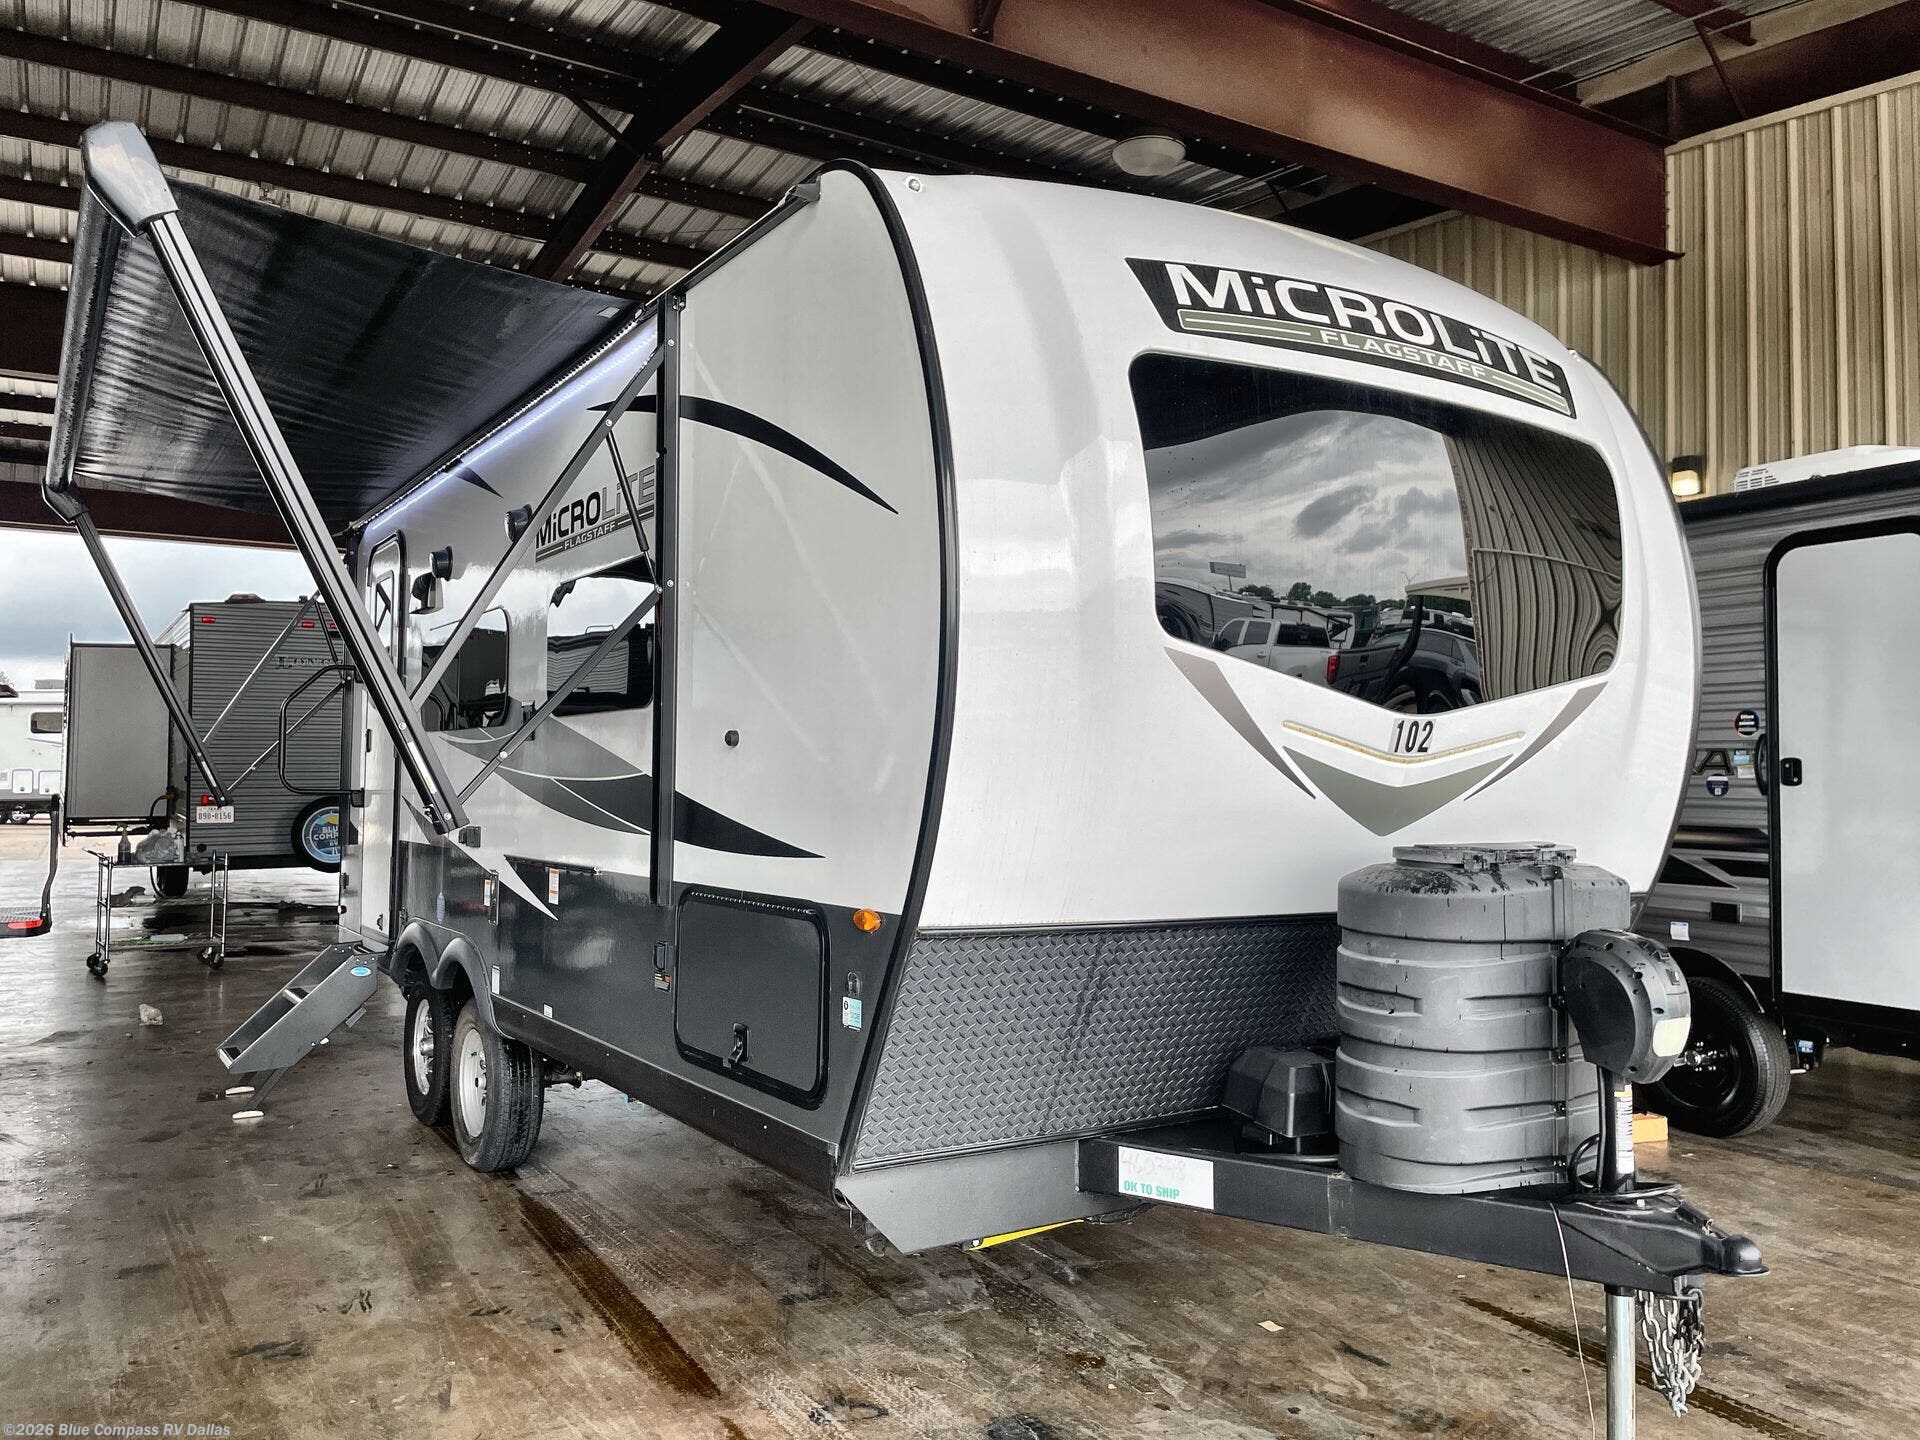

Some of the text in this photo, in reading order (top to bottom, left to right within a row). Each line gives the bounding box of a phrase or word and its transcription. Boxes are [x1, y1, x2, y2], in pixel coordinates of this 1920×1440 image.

[1318, 329, 1487, 379] FLAGSTAFF
[563, 520, 616, 550] FLAGSTAFF
[1393, 719, 1434, 753] 102
[313, 832, 339, 841] COMP
[322, 825, 339, 834] BLU
[1123, 1180, 1180, 1200] OK TO SHIP
